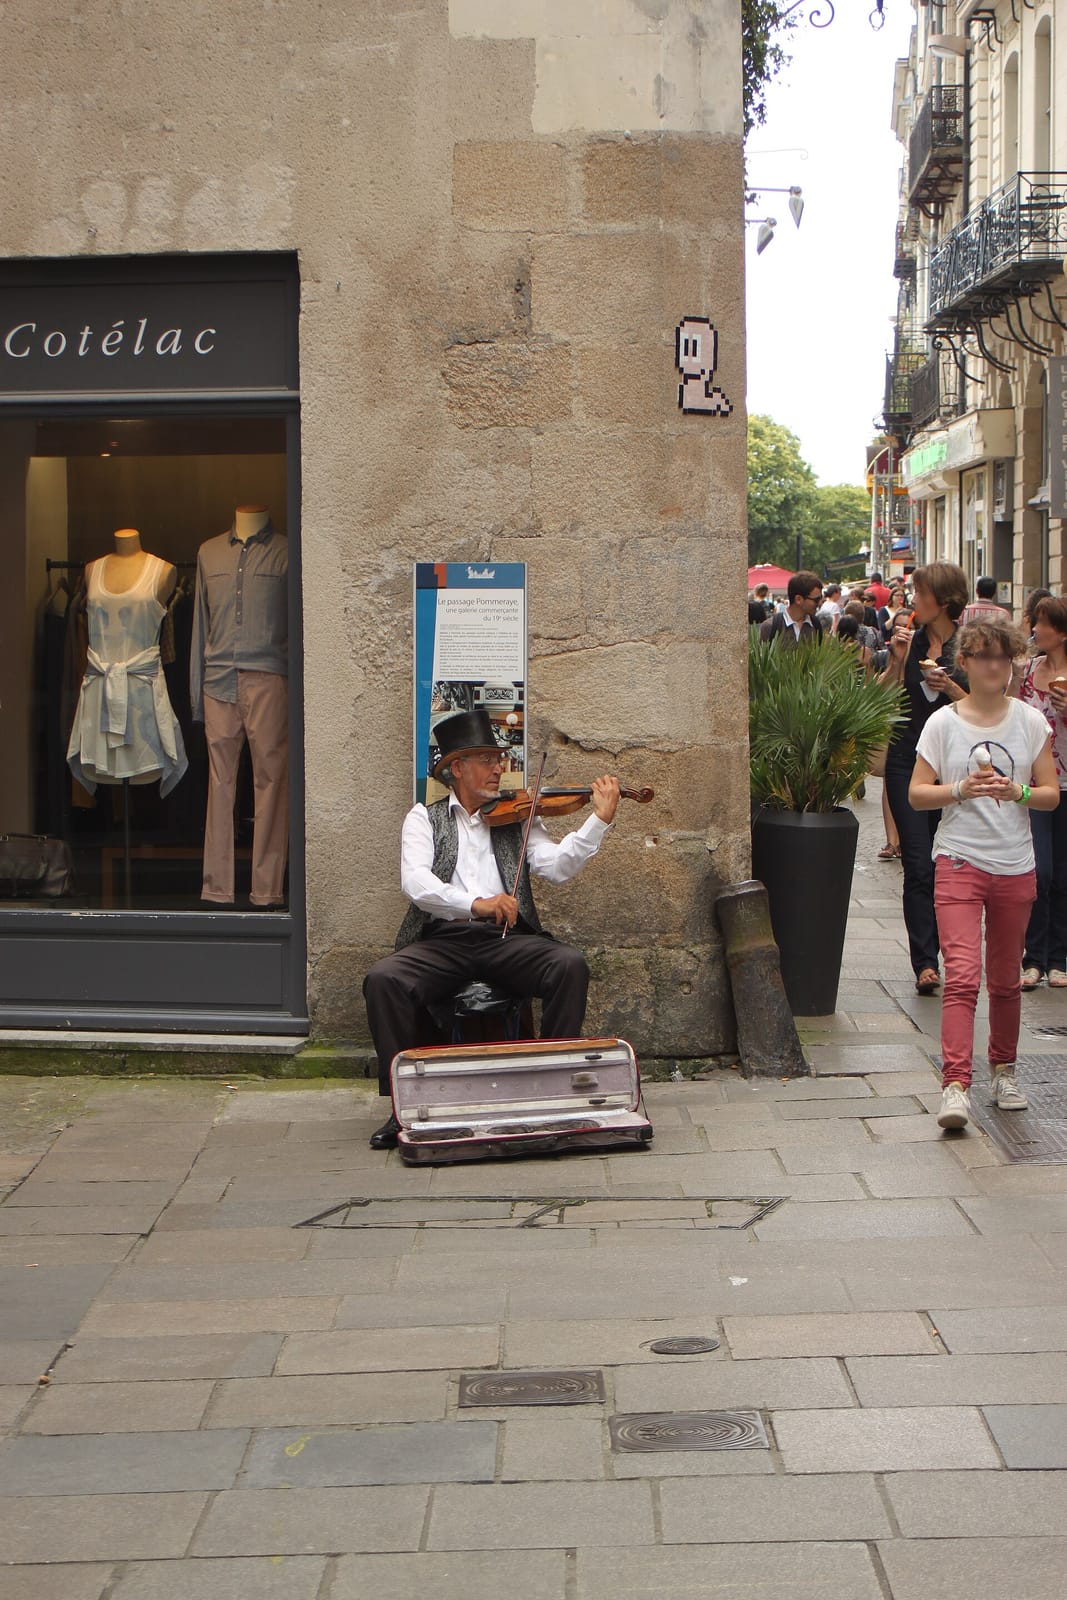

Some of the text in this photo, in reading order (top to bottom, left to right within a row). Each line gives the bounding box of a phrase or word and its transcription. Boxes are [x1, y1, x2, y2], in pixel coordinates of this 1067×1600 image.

[4, 318, 218, 357] Cotélac
[438, 598, 447, 606] Le
[447, 599, 475, 607] passage
